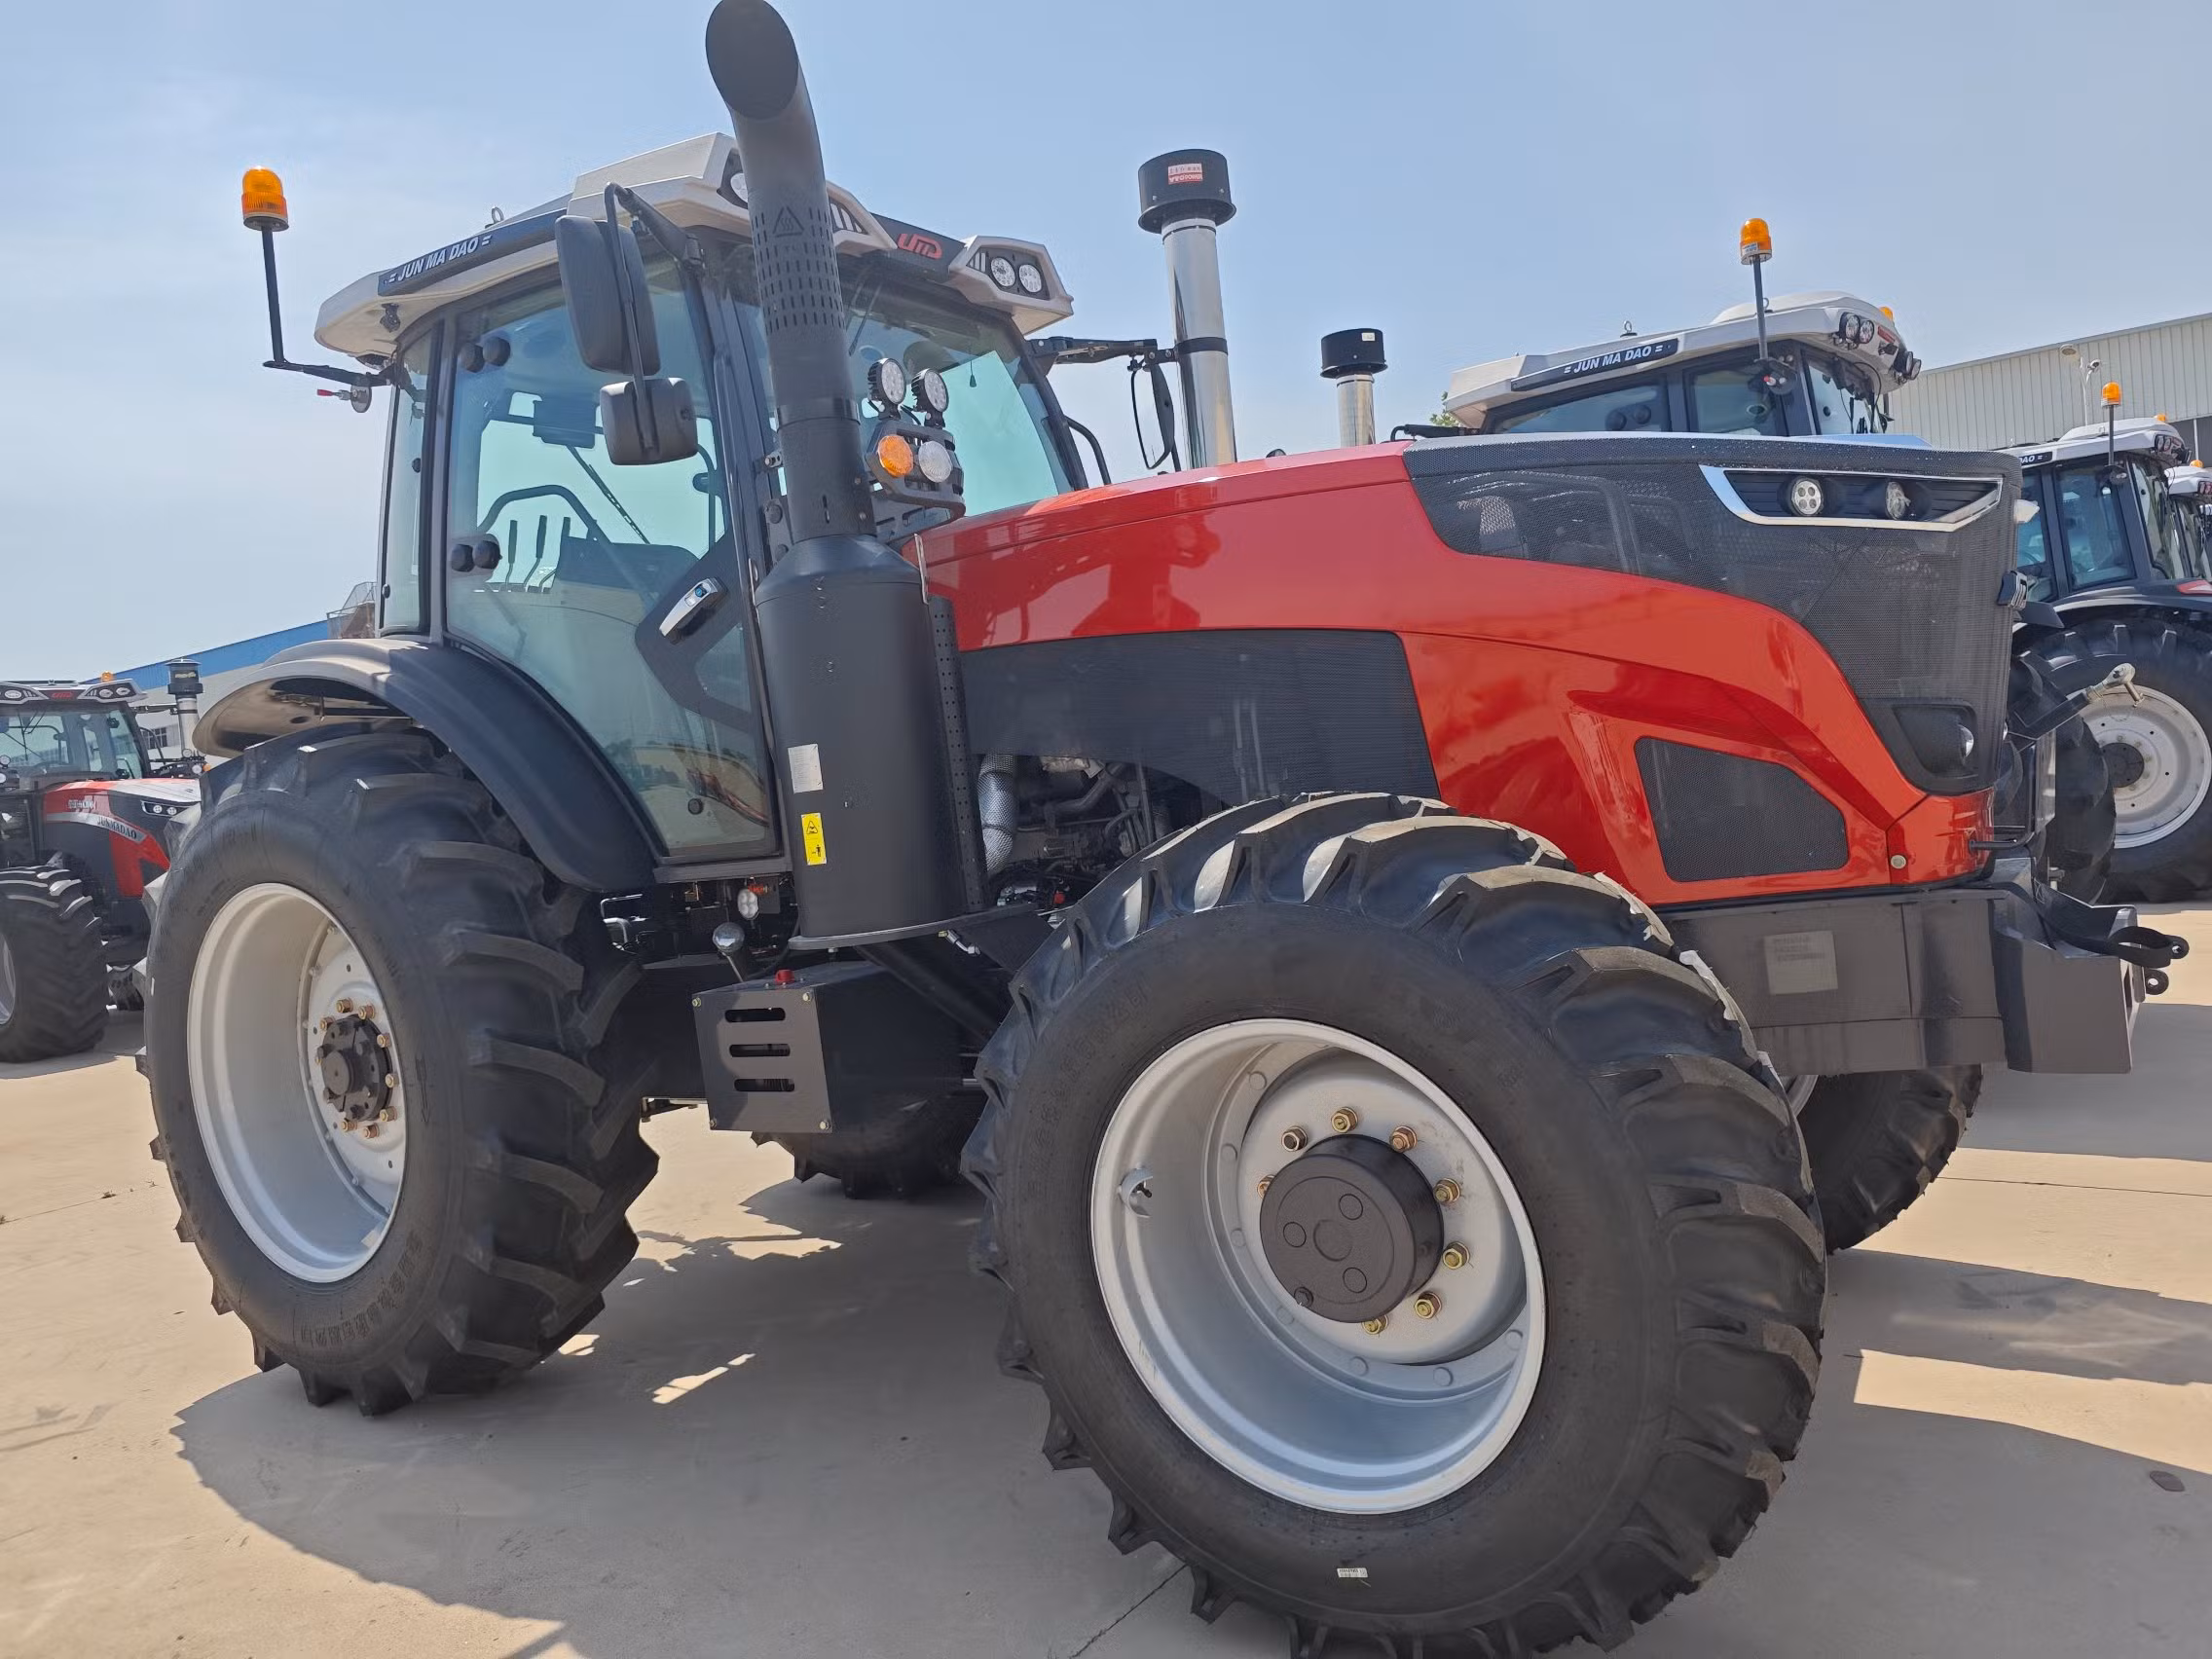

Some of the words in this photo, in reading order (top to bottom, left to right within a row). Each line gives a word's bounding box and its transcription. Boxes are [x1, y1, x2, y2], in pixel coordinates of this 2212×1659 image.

[398, 258, 424, 281] JUN
[425, 250, 446, 270] MA
[448, 237, 479, 261] DAO
[1573, 357, 1601, 374] JUN
[1603, 351, 1621, 367] MA
[1624, 345, 1652, 362] DAO
